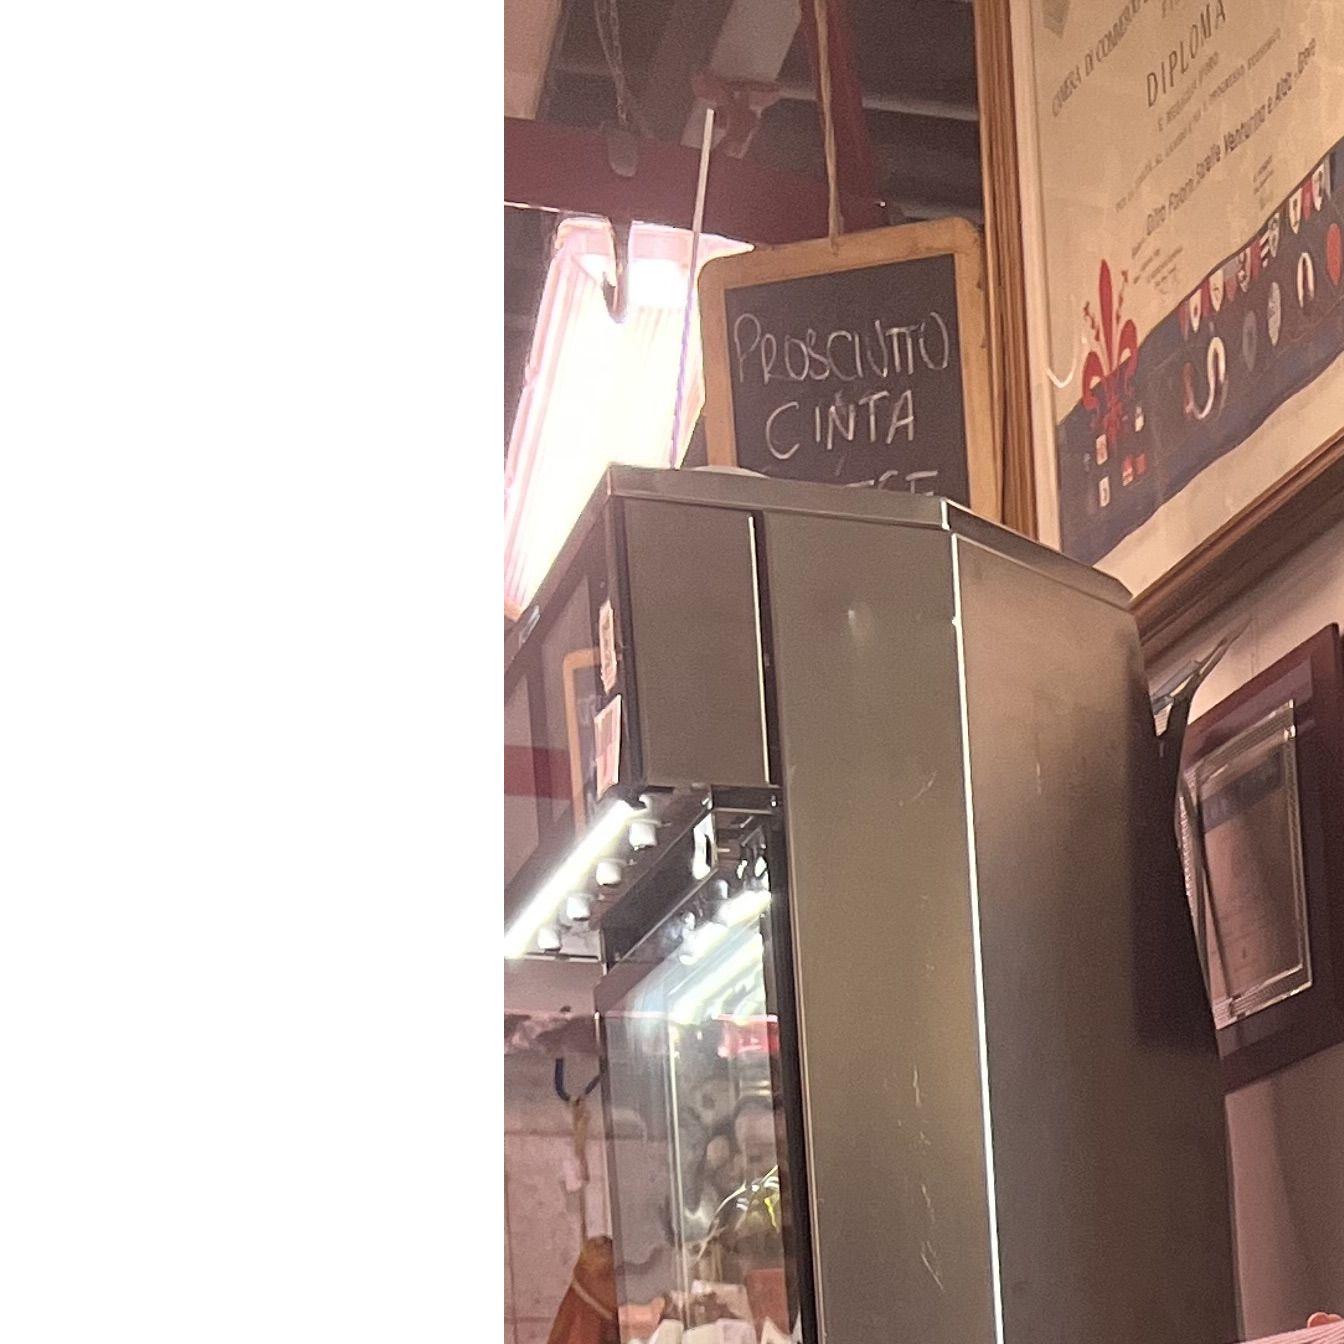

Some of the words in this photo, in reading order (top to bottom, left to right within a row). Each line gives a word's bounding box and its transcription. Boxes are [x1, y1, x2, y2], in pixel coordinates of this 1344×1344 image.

[1146, 0, 1226, 107] DIPLOMA
[734, 312, 949, 385] PROSCIUTTO
[766, 389, 914, 460] CINTA
